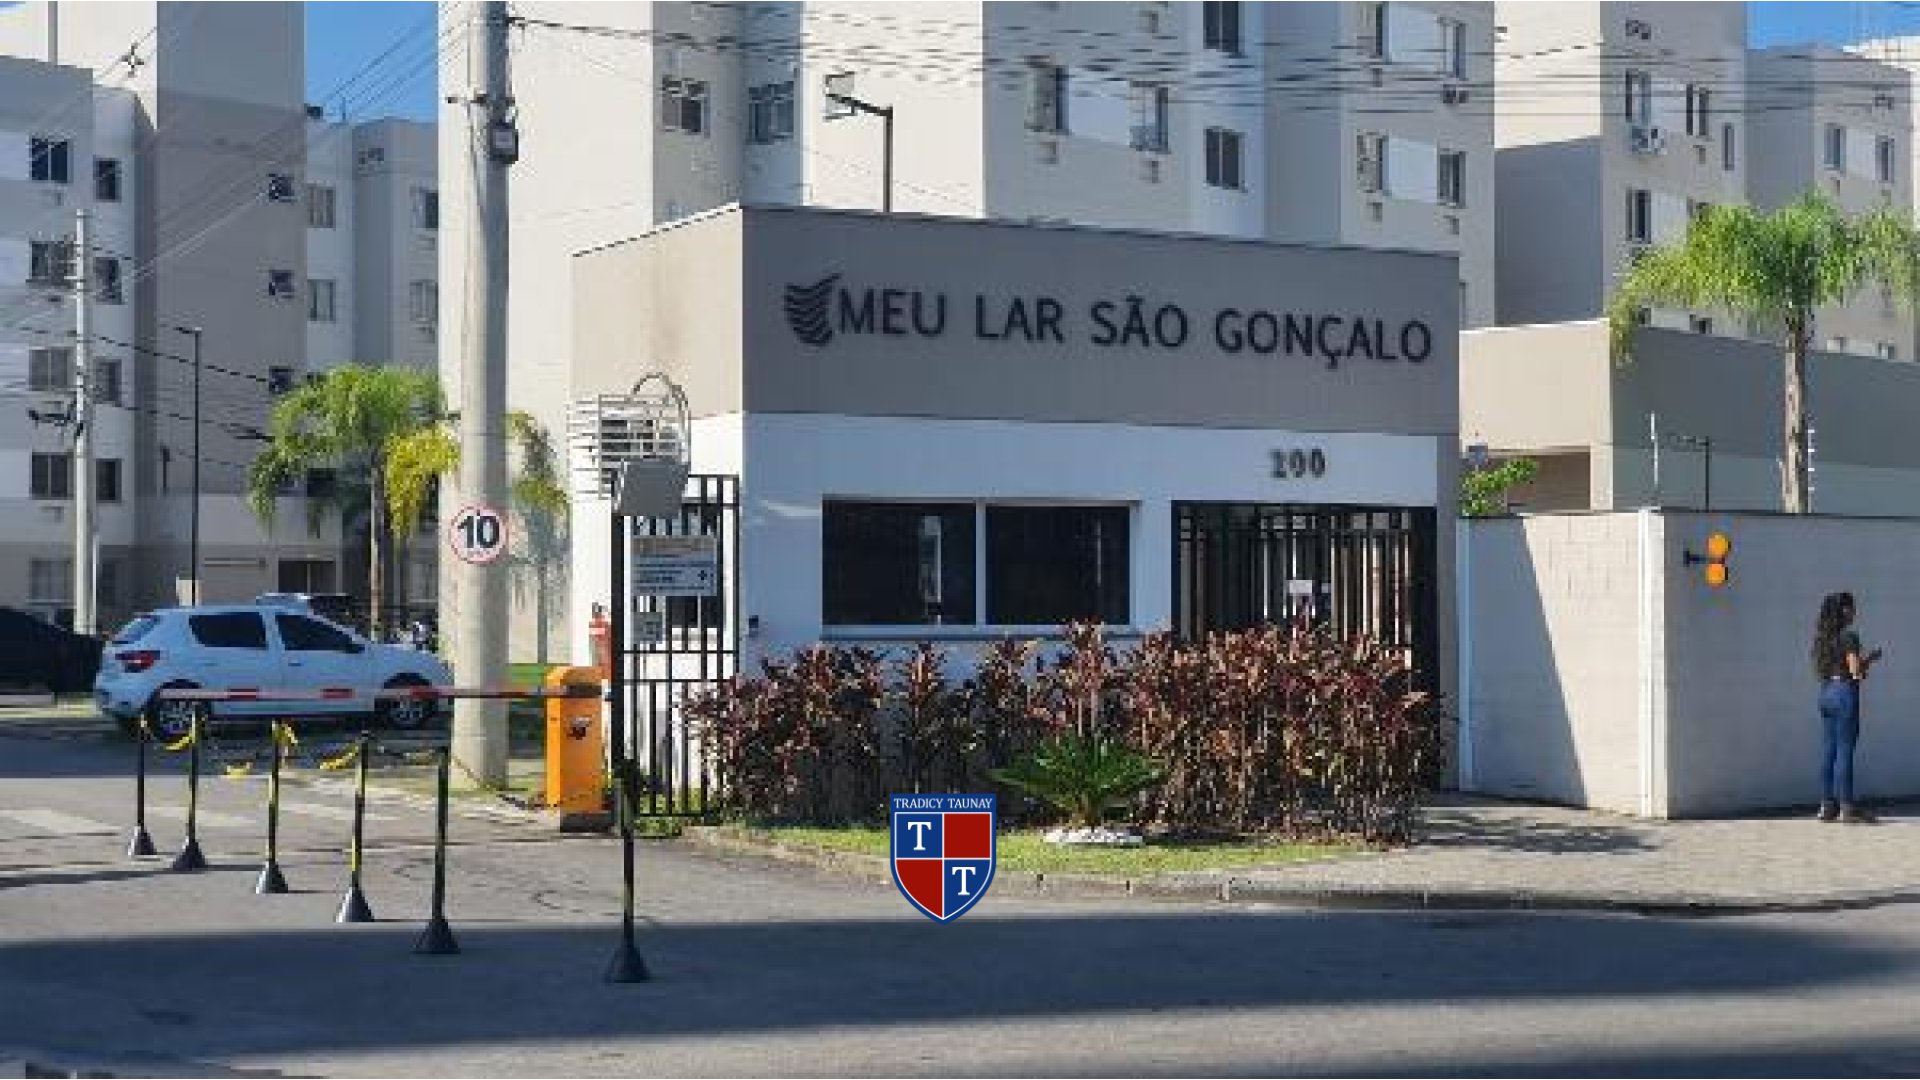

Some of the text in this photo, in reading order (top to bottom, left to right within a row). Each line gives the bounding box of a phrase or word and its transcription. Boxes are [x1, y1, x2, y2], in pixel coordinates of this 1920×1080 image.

[839, 287, 1432, 371] MEU LAR SÃO GONÇALO
[457, 515, 500, 549] 10
